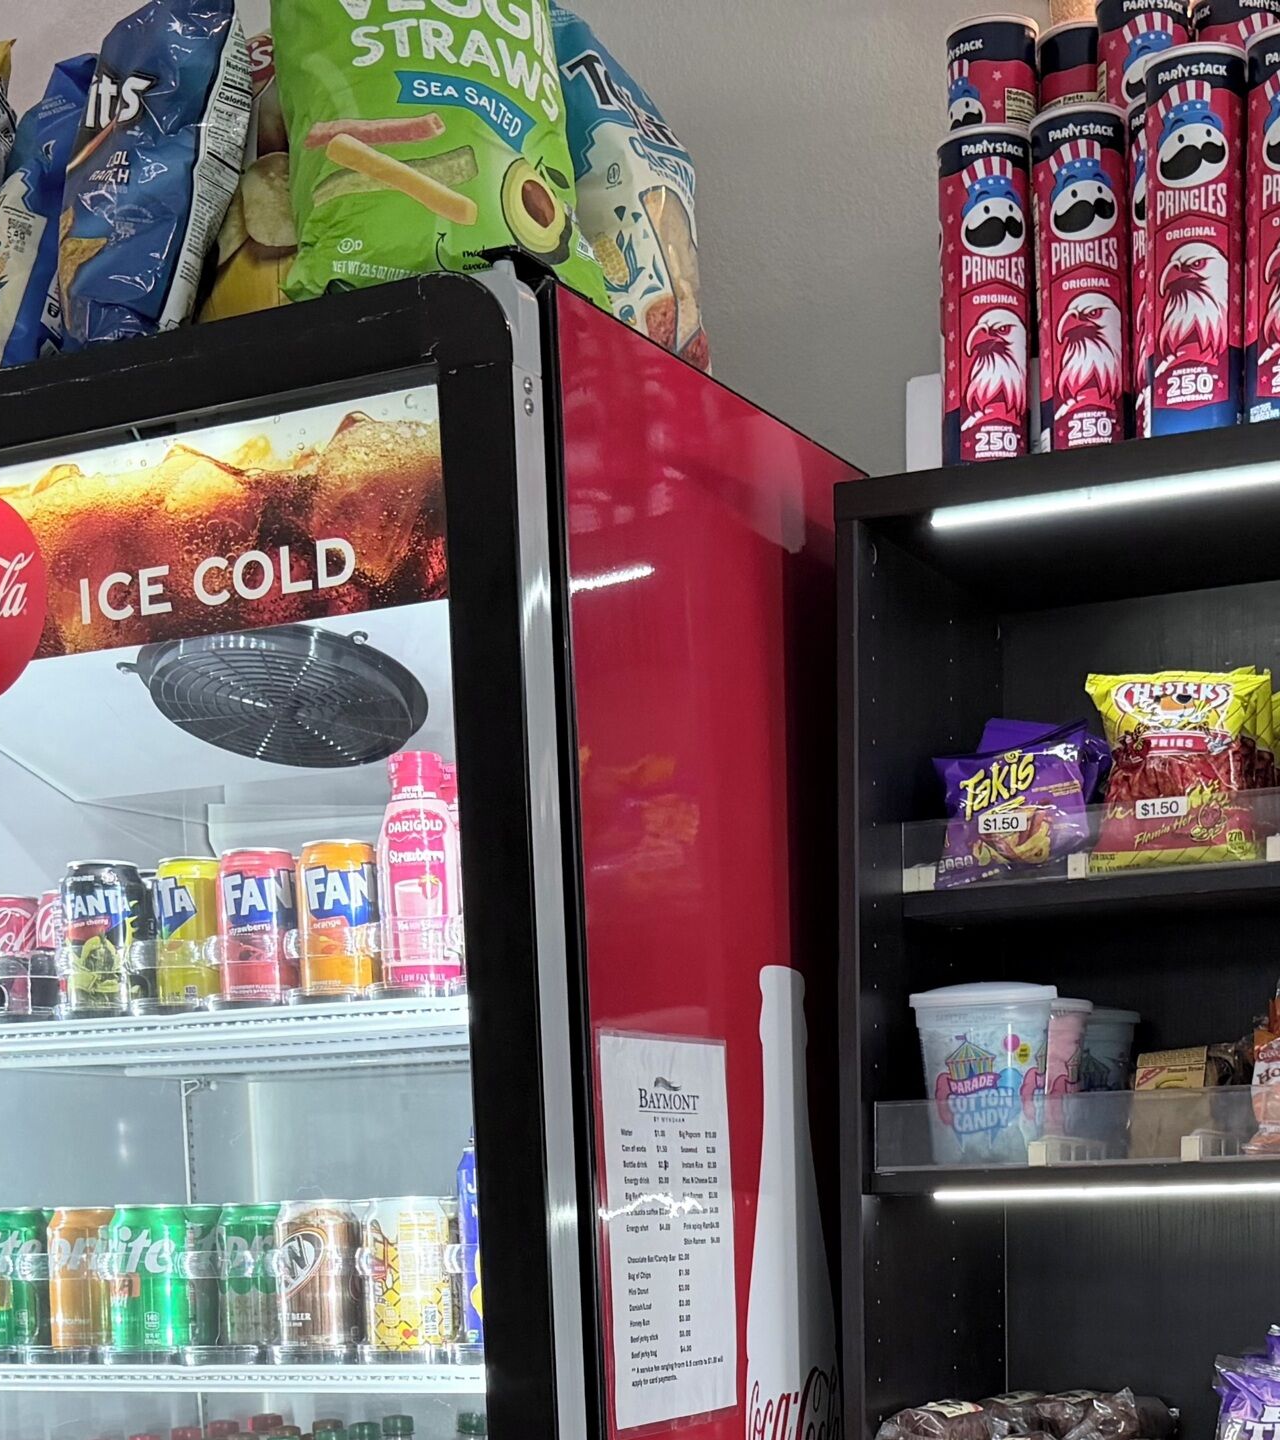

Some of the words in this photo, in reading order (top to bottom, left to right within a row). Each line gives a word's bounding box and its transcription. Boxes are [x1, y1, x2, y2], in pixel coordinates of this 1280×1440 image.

[351, 18, 559, 122] STRAWS
[413, 80, 459, 97] SEA
[464, 87, 522, 137] SALTED
[1156, 183, 1227, 225] PRINGLES
[79, 564, 172, 626] ICE
[192, 536, 358, 608] COLD
[1149, 738, 1194, 749] FRIES
[959, 750, 1036, 822] Takis
[1140, 801, 1181, 817] $1.50
[387, 818, 444, 834] DARIGOLD
[982, 816, 1020, 832] $1.50
[389, 849, 444, 864] Strawberry
[313, 918, 341, 928] orange
[949, 1074, 994, 1094] PARADE
[638, 1088, 699, 1111] BAYMONT
[949, 1090, 1012, 1114] COTTON
[953, 1110, 1010, 1131] CANDY
